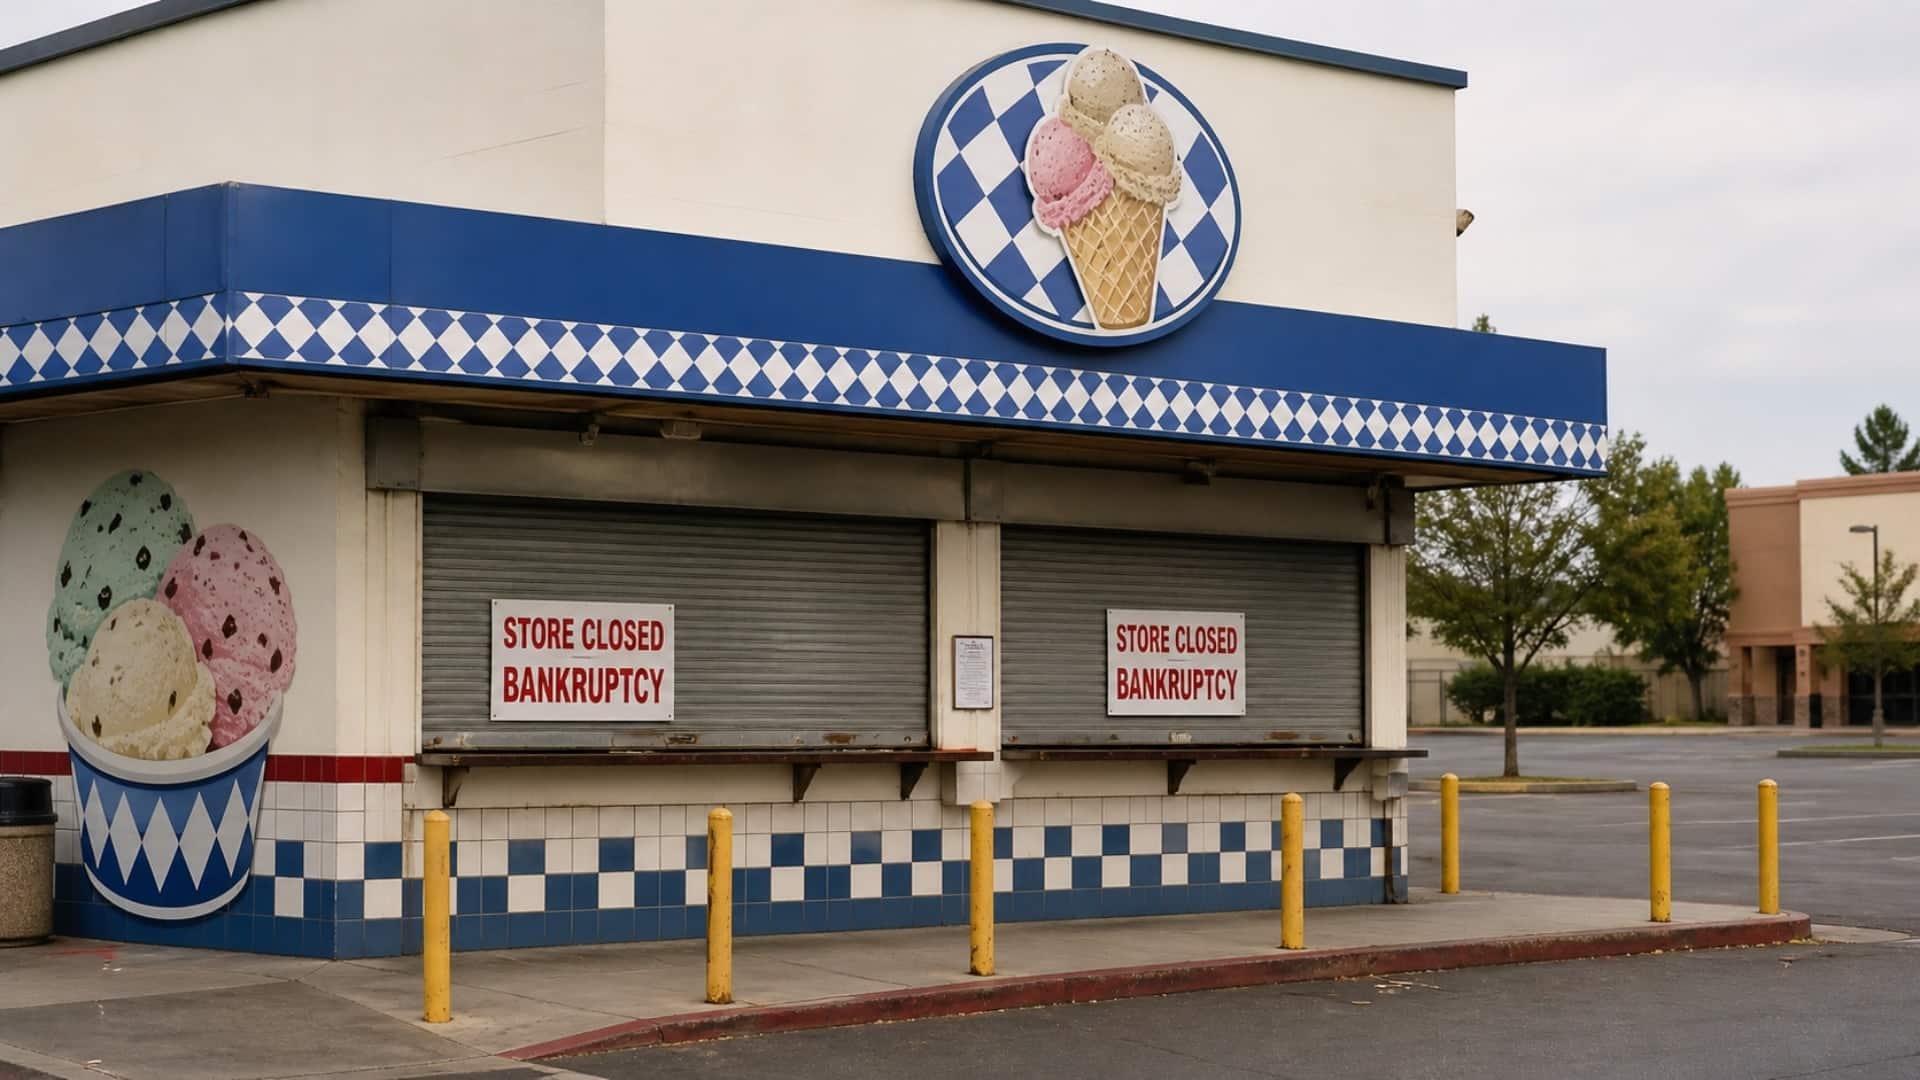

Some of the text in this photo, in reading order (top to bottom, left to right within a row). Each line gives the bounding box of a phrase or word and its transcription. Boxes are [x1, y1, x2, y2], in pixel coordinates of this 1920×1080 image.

[503, 616, 665, 651] STORE CLOSED
[1116, 624, 1237, 654] STORE CLOSED
[503, 666, 665, 704] BANKRUPTCY
[1116, 667, 1238, 701] BANKRUPTCY
